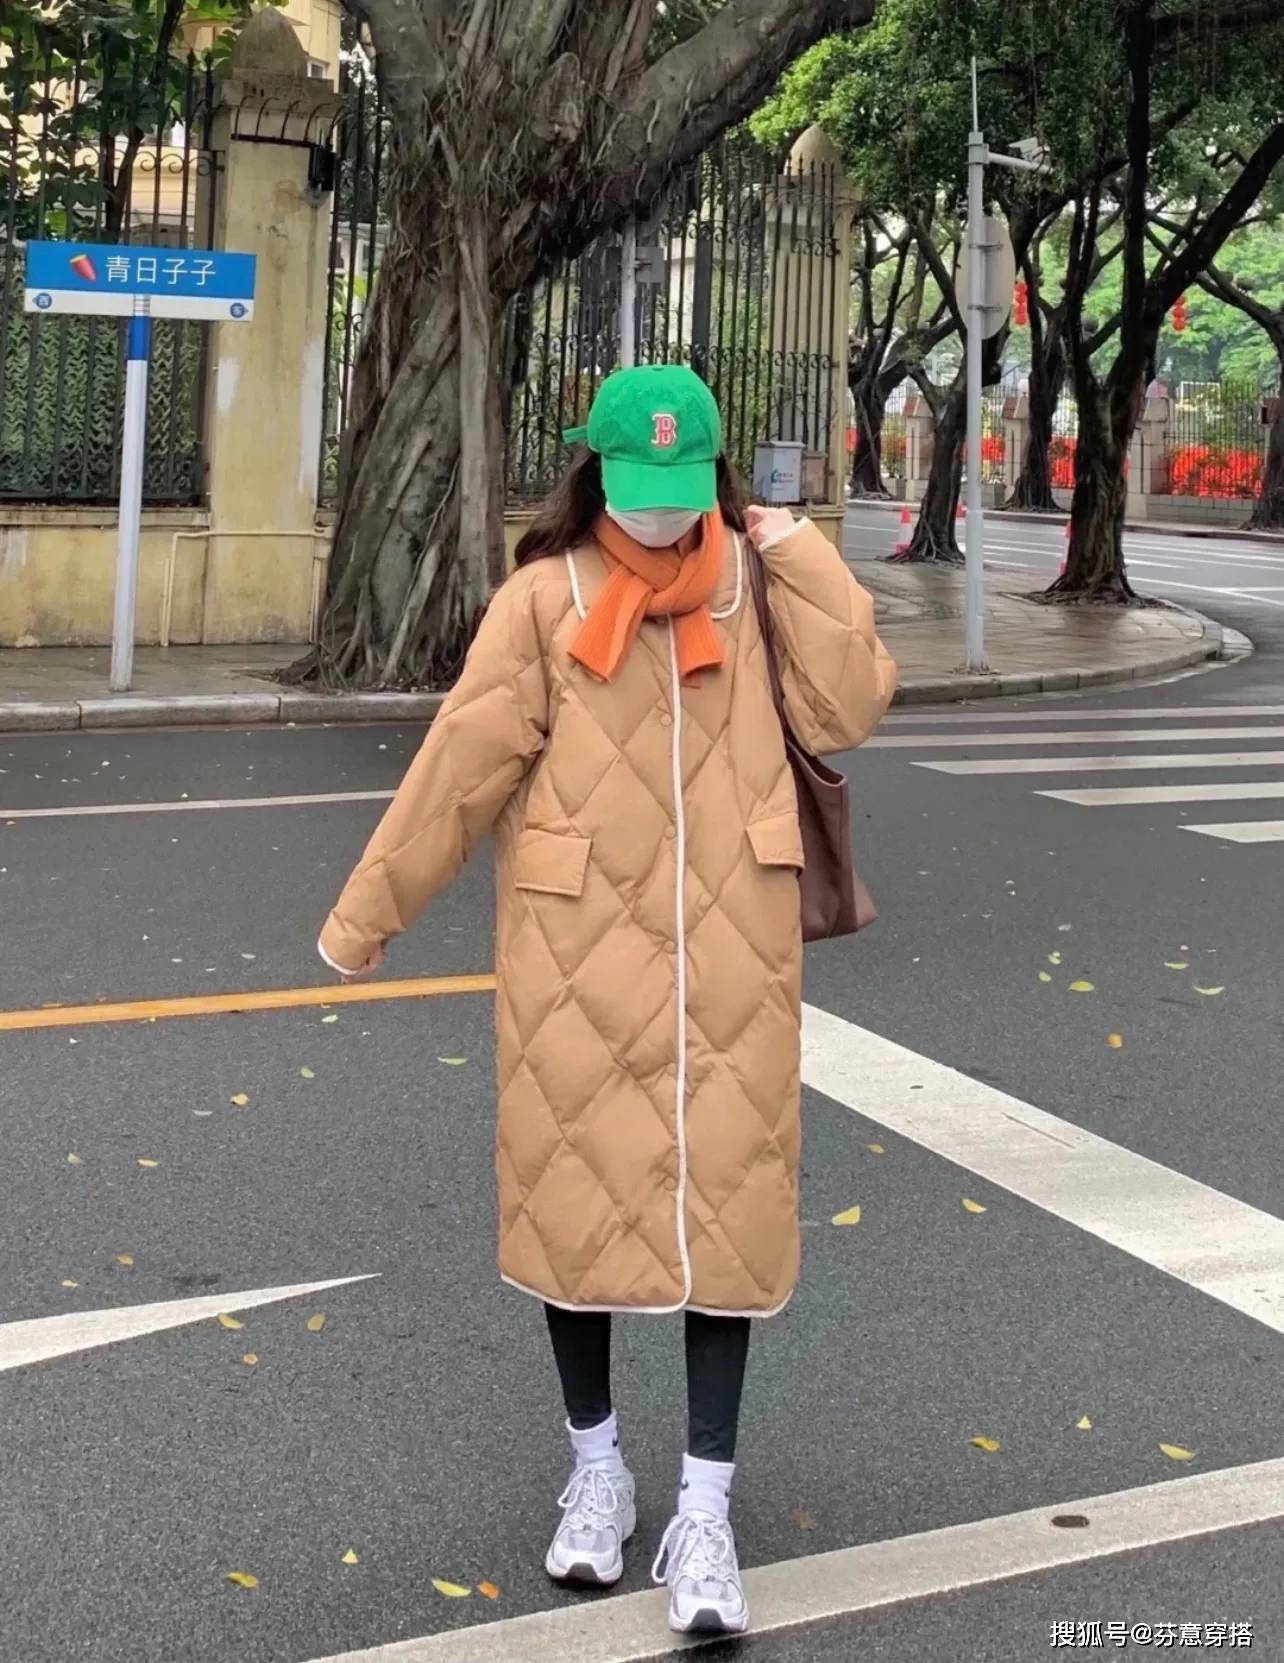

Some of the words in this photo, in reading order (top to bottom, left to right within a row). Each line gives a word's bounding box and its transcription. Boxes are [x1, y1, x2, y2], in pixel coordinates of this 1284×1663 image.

[105, 255, 216, 286] 青日子子
[651, 413, 677, 448] B
